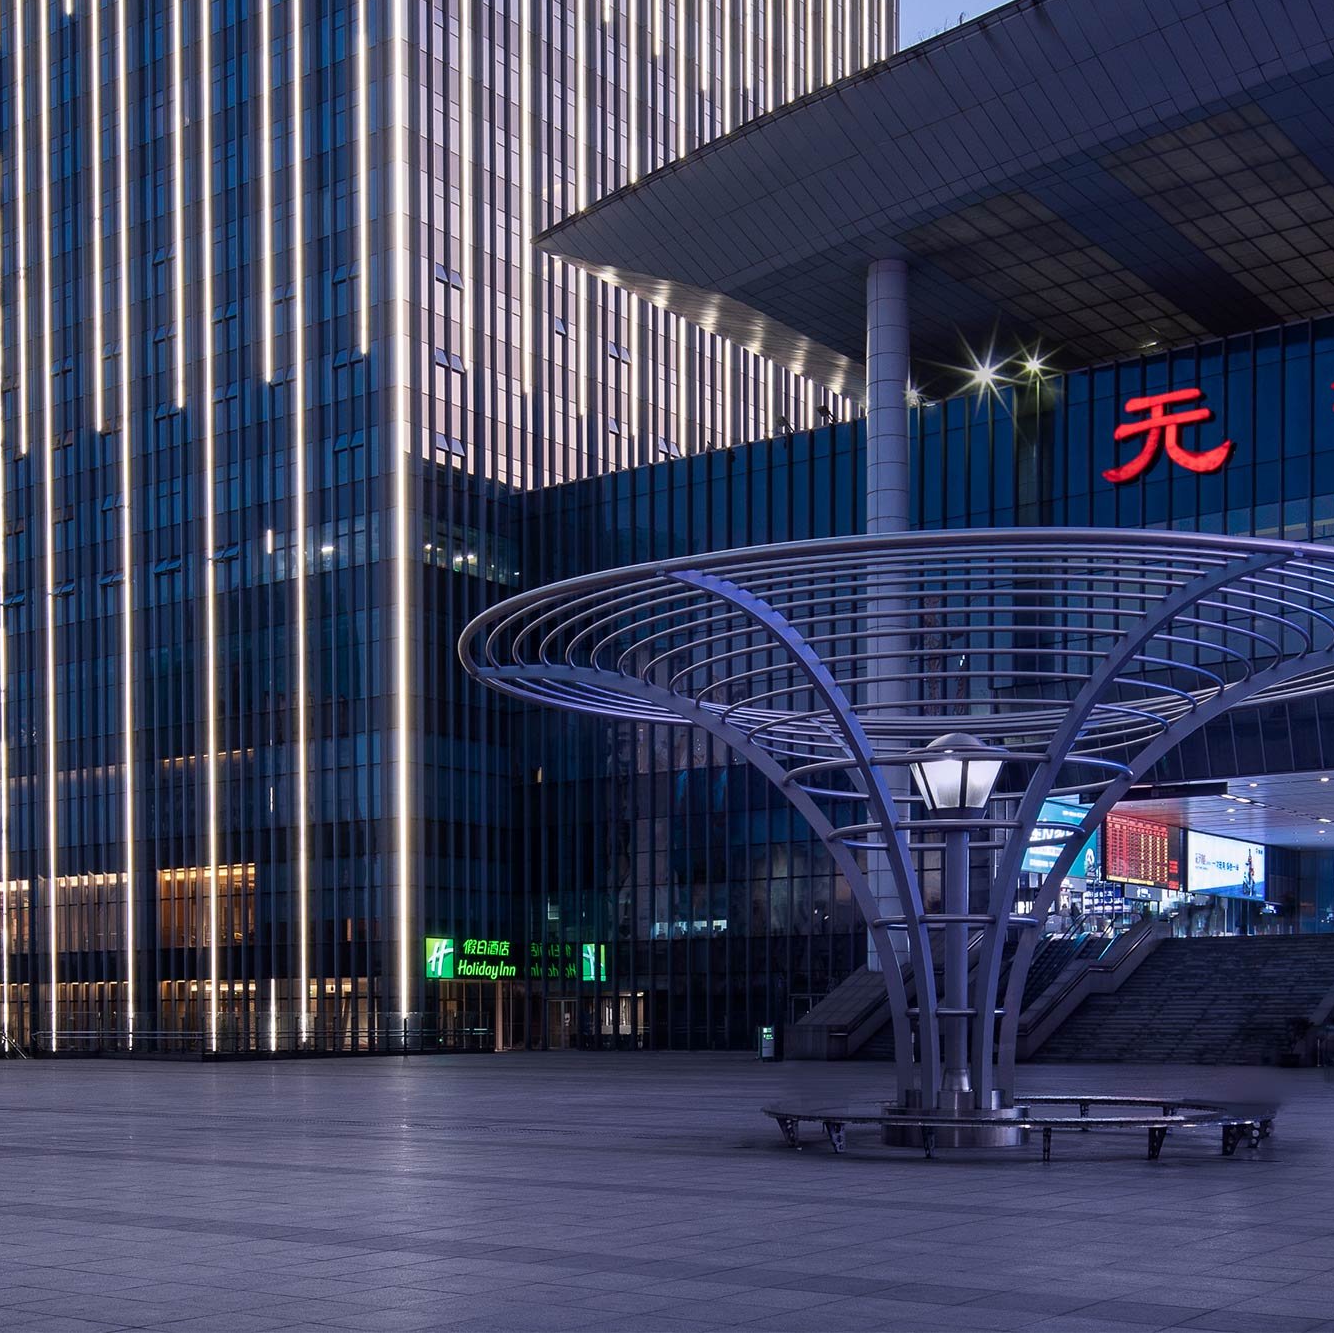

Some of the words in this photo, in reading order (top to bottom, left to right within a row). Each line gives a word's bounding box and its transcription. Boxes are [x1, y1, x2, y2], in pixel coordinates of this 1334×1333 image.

[463, 939, 510, 957] 假日酒店
[458, 959, 498, 980] Holiday
[499, 961, 516, 977] Inn
